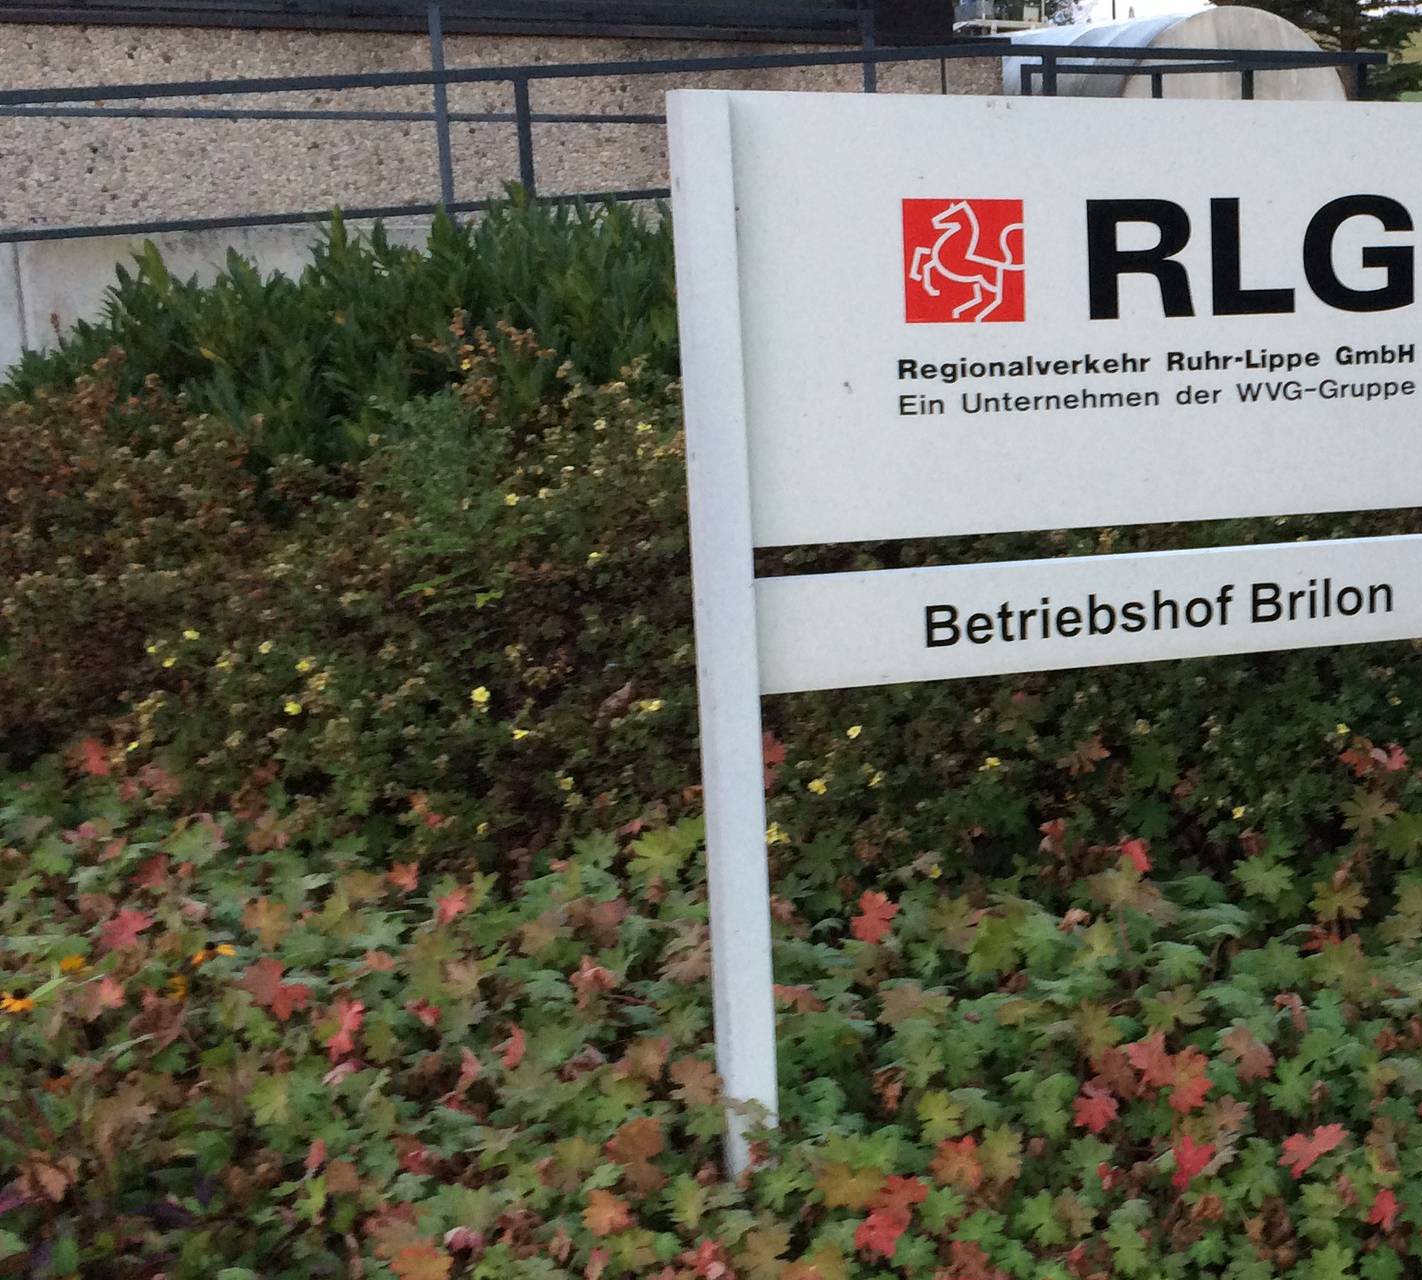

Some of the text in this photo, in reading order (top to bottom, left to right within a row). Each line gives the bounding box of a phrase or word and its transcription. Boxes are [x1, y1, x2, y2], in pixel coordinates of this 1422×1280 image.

[1086, 194, 1415, 321] RLG
[898, 344, 1415, 384] Regionalverkehr Ruhr-Lippe GmbH
[898, 379, 1415, 416] Ein Unternehmen der WVG-Gruppe
[925, 578, 1393, 648] Betriebshof Brilon
